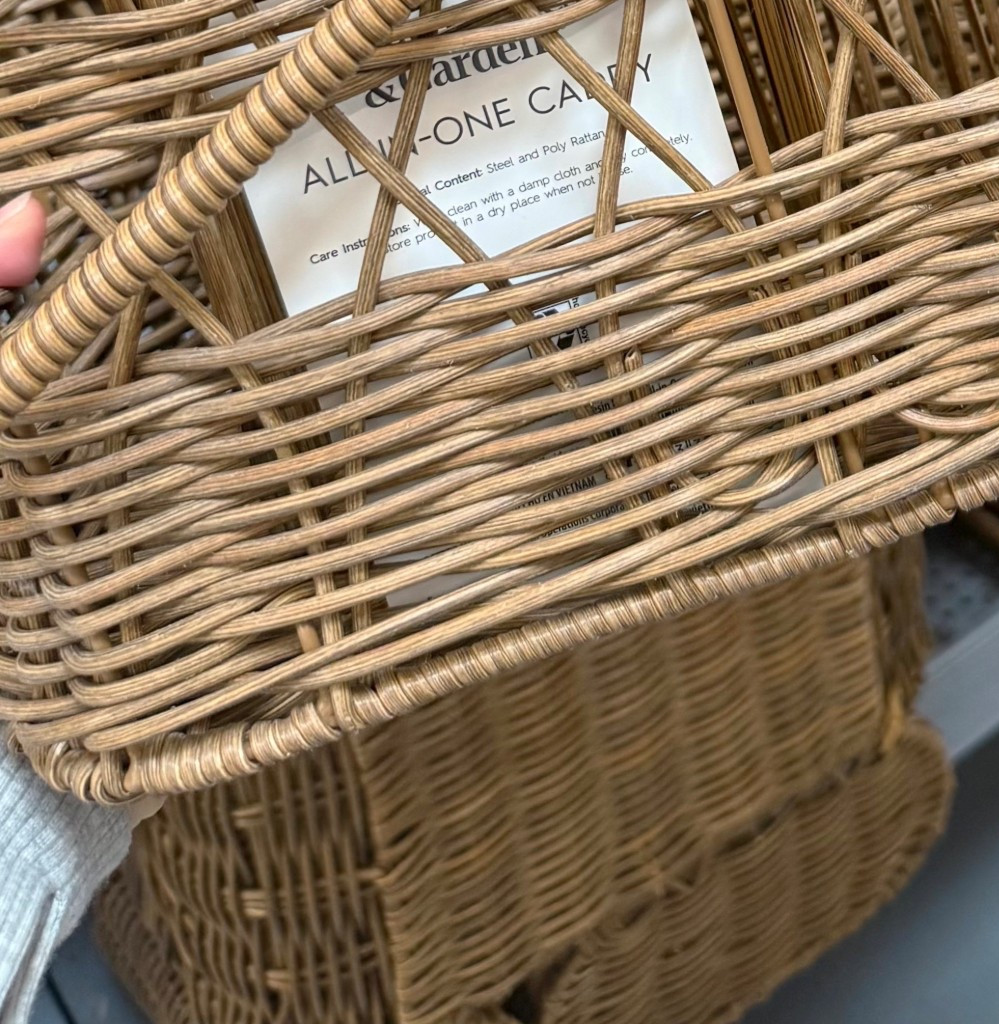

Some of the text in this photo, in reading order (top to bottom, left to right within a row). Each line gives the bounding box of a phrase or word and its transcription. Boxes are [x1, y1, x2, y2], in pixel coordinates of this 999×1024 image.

[435, 130, 605, 191] Content: Steel and Poly Rattan
[309, 247, 339, 265] Care
[342, 223, 411, 254] Instrons:
[447, 200, 478, 217] clean
[481, 191, 504, 205] with
[507, 188, 515, 197] a
[518, 176, 550, 193] damp
[554, 166, 581, 182] cloth
[462, 216, 473, 227] in
[477, 213, 485, 222] a
[488, 205, 506, 218] dry
[510, 194, 541, 212] place
[544, 182, 574, 199] when
[577, 175, 596, 189] not
[555, 475, 597, 497] VIETNAM
